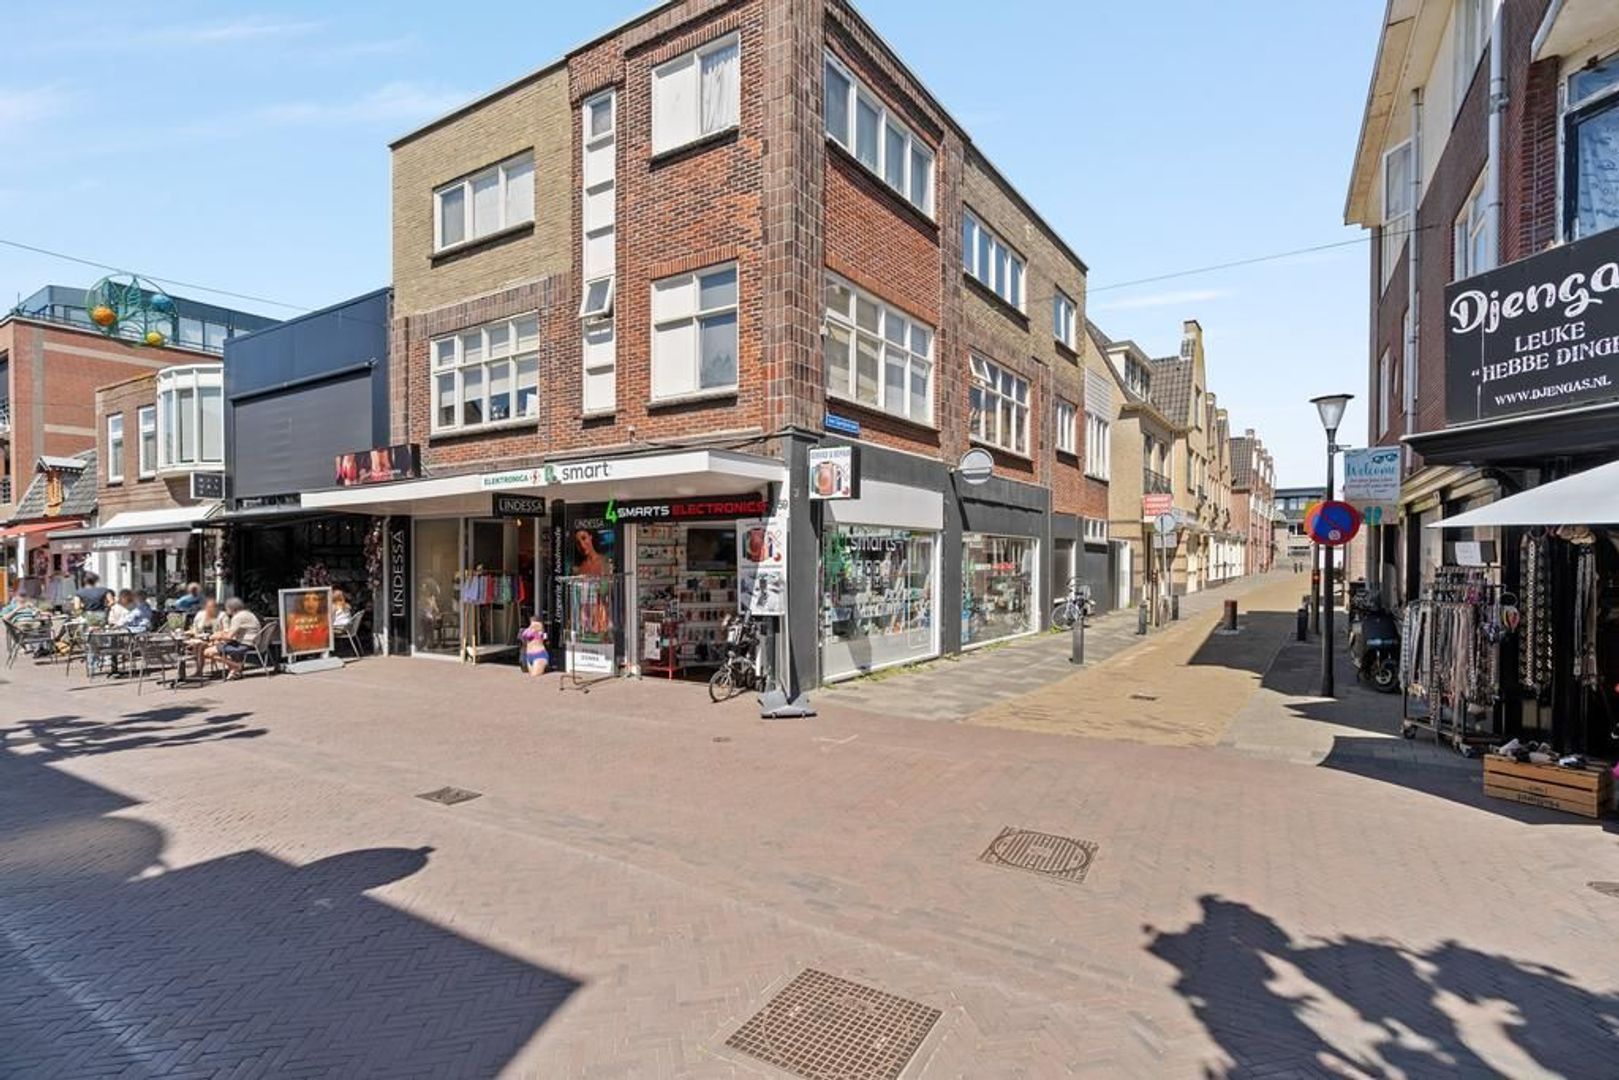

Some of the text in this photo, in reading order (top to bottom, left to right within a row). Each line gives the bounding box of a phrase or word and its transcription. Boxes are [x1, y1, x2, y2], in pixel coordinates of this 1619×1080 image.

[1514, 321, 1586, 352] LEUKE
[1494, 374, 1613, 407] WWW.DJENGAS.NL
[1346, 462, 1396, 477] Welcome
[484, 474, 529, 486] ELEKTRONICA
[499, 498, 545, 514] LINDESSA
[672, 501, 769, 517] ELECTRONICS
[392, 530, 405, 617] LINDESSA
